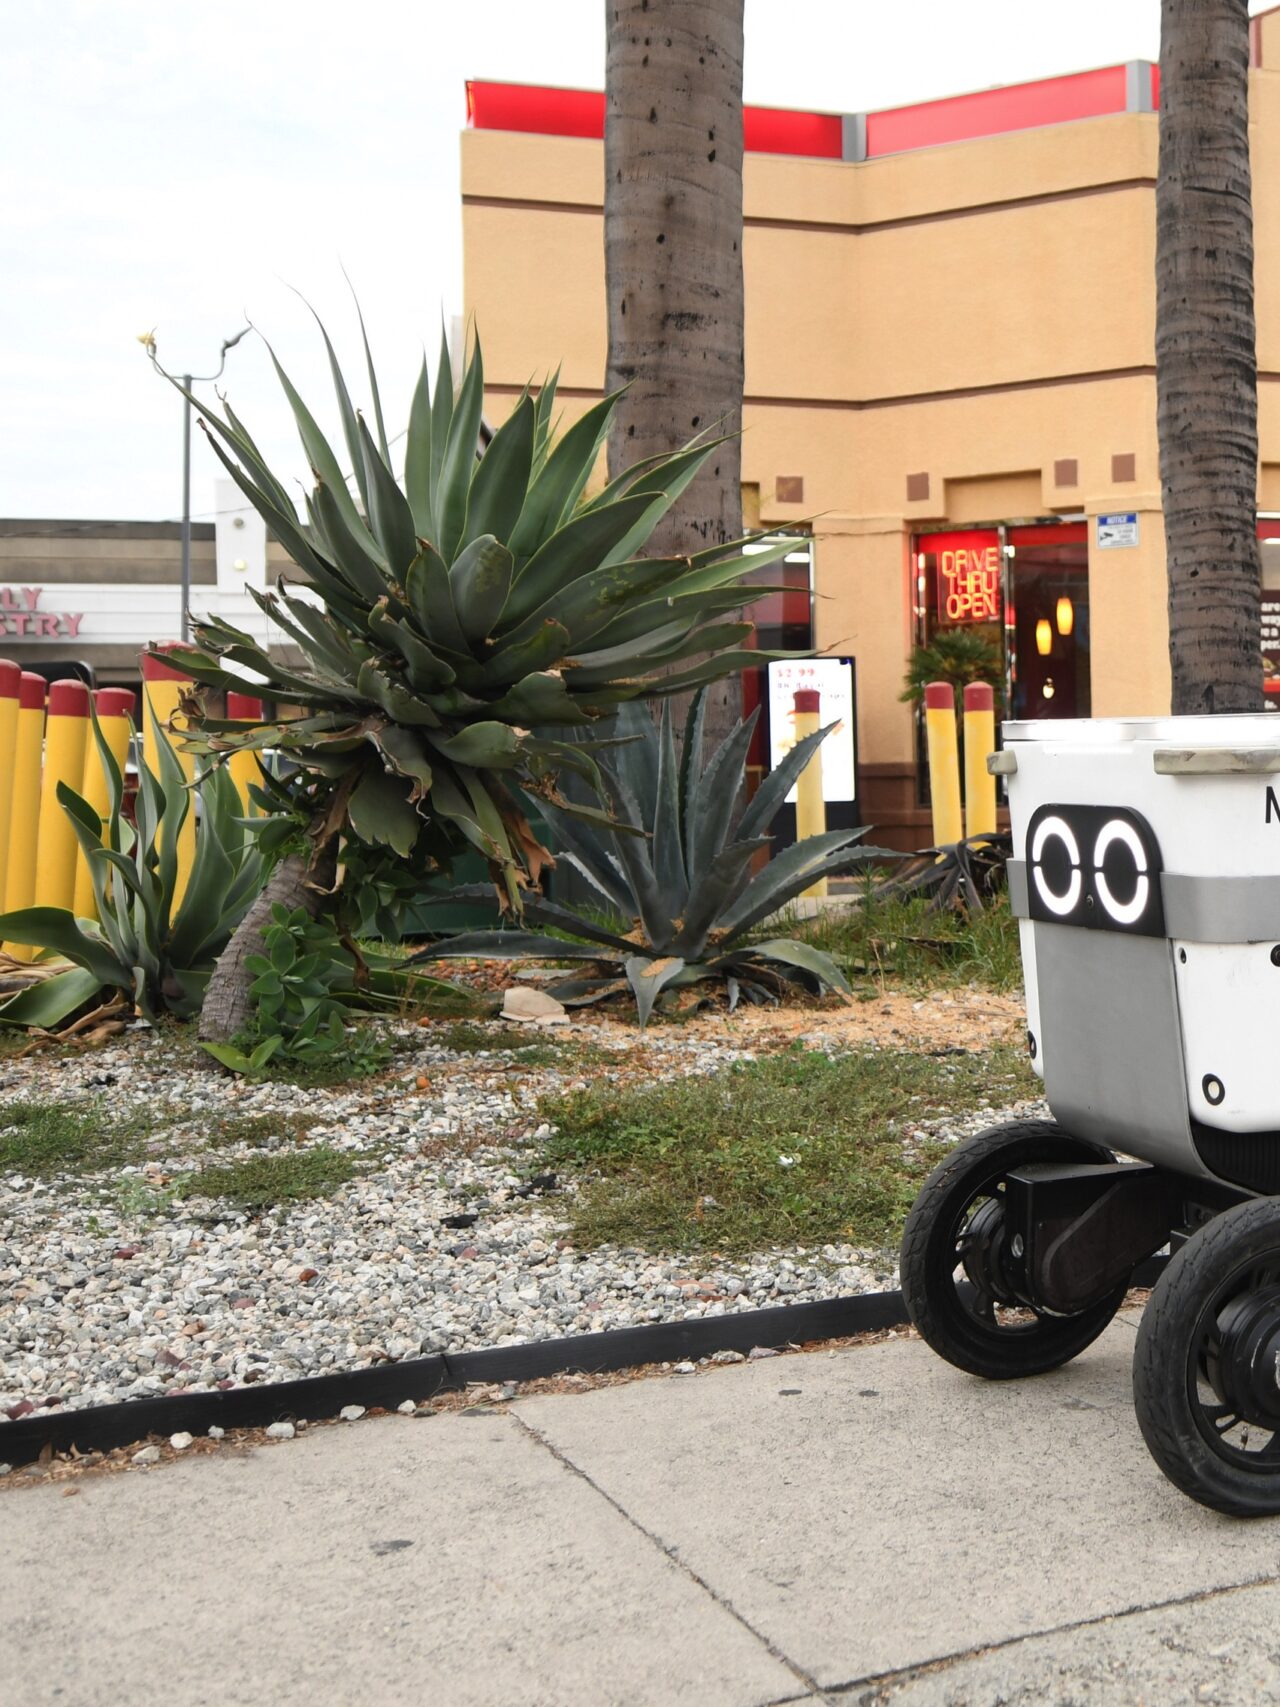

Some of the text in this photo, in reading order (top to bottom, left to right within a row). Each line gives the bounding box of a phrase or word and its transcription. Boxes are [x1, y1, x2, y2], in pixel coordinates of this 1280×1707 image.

[941, 547, 998, 576] DRIVE
[946, 570, 998, 595] THRU
[946, 592, 997, 619] OPEN
[1261, 602, 1280, 612] are
